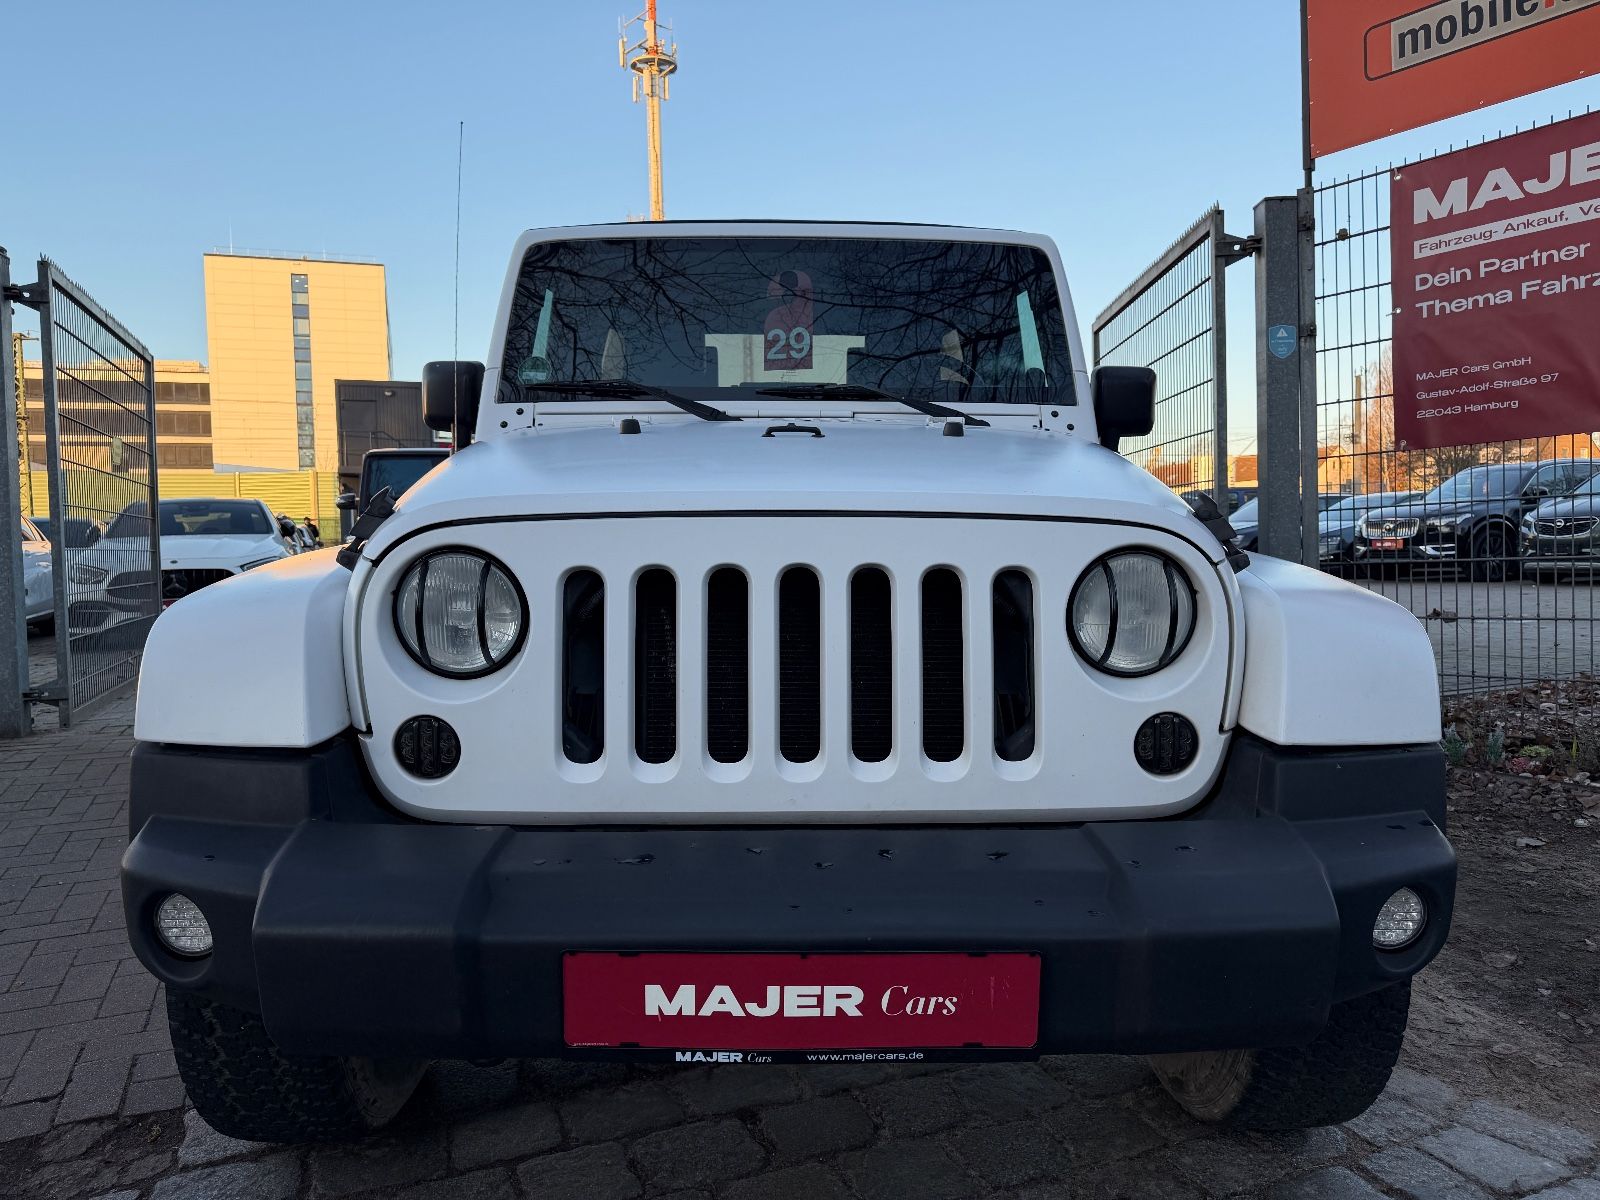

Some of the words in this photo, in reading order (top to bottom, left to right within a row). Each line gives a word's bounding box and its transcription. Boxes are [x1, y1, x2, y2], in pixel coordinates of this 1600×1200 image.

[1413, 140, 1600, 225] MAJE
[1418, 229, 1498, 254] Fahrzeug-
[1503, 210, 1569, 235] Ankauf,
[1415, 267, 1472, 291] Dein
[1479, 242, 1591, 278] Partner
[1415, 289, 1513, 319] Thema
[767, 326, 811, 360] 29
[1416, 367, 1459, 381] MAJER
[1461, 364, 1490, 374] Cars
[1493, 356, 1532, 370] GmbH
[1416, 377, 1538, 400] Gustav-Adolf-Straße
[1540, 372, 1560, 383] 97
[1416, 405, 1462, 419] 22043
[1464, 400, 1519, 413] Hamburg
[644, 984, 864, 1018] MAJER
[881, 985, 958, 1017] Cars
[675, 1051, 743, 1063] MAJER
[747, 1052, 773, 1063] Cars
[806, 1052, 924, 1062] www.majercars.de
